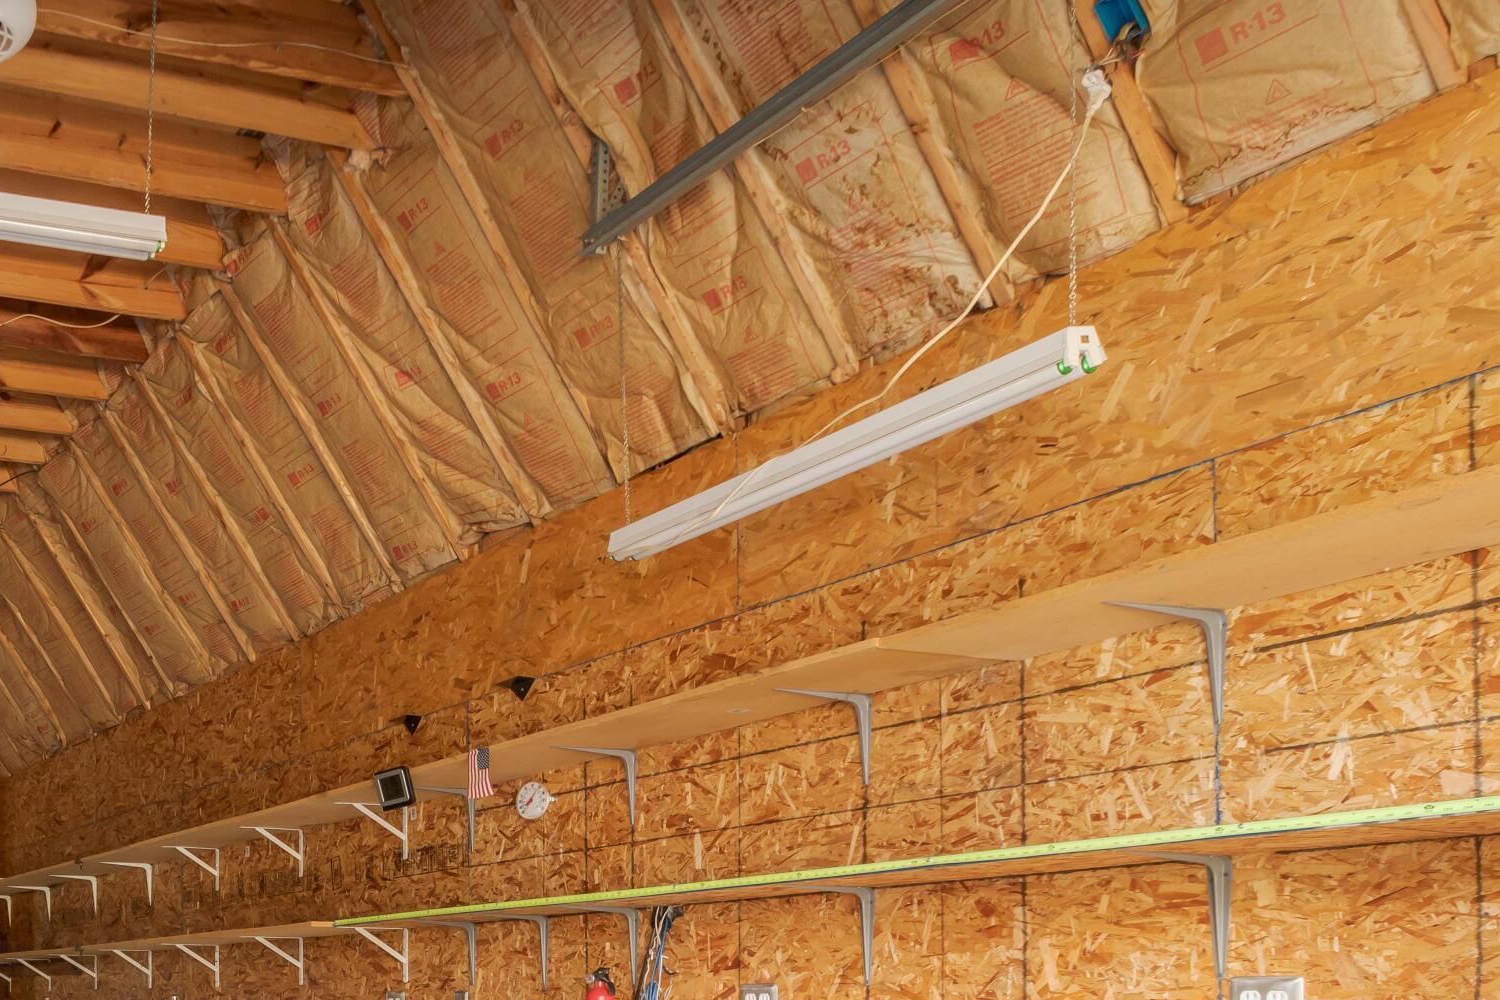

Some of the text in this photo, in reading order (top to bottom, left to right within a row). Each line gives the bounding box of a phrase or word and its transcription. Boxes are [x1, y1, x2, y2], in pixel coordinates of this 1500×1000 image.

[1228, 2, 1287, 44] R-13
[501, 118, 525, 144] R-13
[408, 198, 429, 222] R-13
[499, 371, 522, 393] R-13
